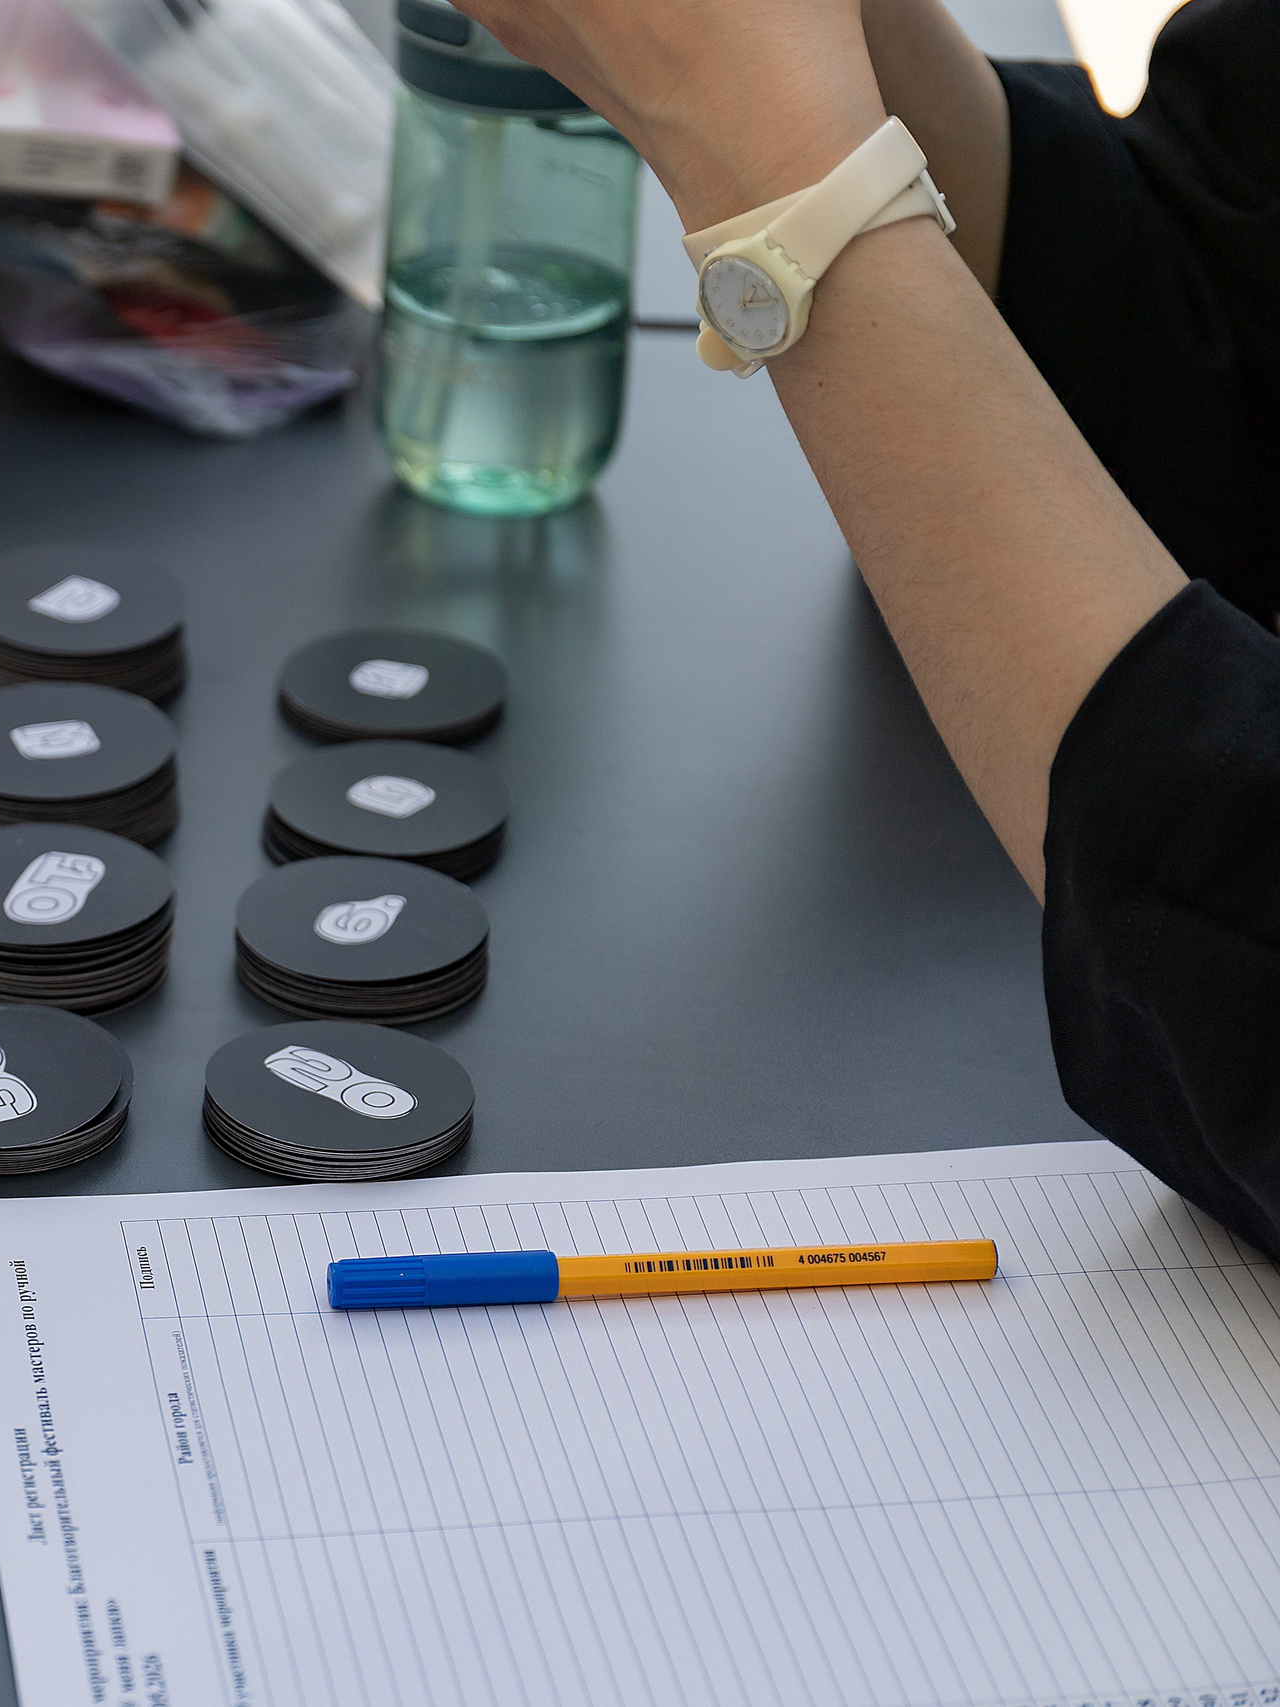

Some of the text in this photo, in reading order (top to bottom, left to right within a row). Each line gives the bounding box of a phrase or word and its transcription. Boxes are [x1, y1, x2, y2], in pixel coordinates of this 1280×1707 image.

[8, 852, 99, 921] 10
[266, 1048, 417, 1117] 20
[9, 1260, 37, 1303] ручной
[136, 1246, 155, 1290] Подпись
[798, 1250, 887, 1265] 4 004675 004567
[21, 1305, 36, 1320] по
[25, 1323, 47, 1384] мастеров
[171, 1330, 189, 1371] показателей)
[35, 1387, 64, 1457] фестиваль
[168, 1392, 195, 1465] Район города
[13, 1427, 48, 1545] Лист регистрации
[44, 1459, 86, 1595] Благотворительный
[203, 1550, 235, 1629] мероприятия
